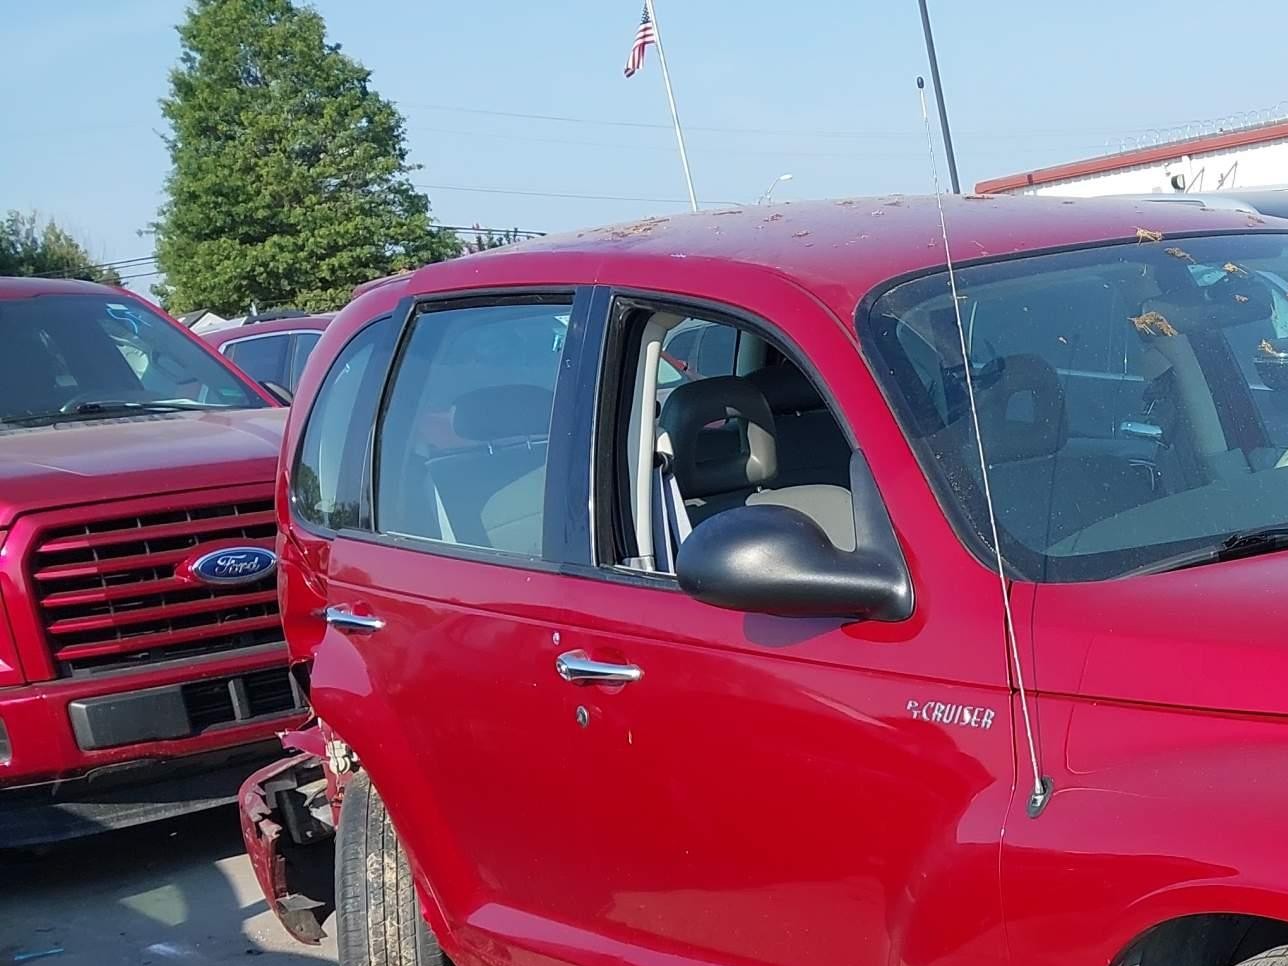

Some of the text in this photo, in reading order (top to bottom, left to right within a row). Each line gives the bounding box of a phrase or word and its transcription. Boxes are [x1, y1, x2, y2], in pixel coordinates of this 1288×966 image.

[215, 554, 260, 573] Ford
[906, 699, 995, 729] PT CRUISER
